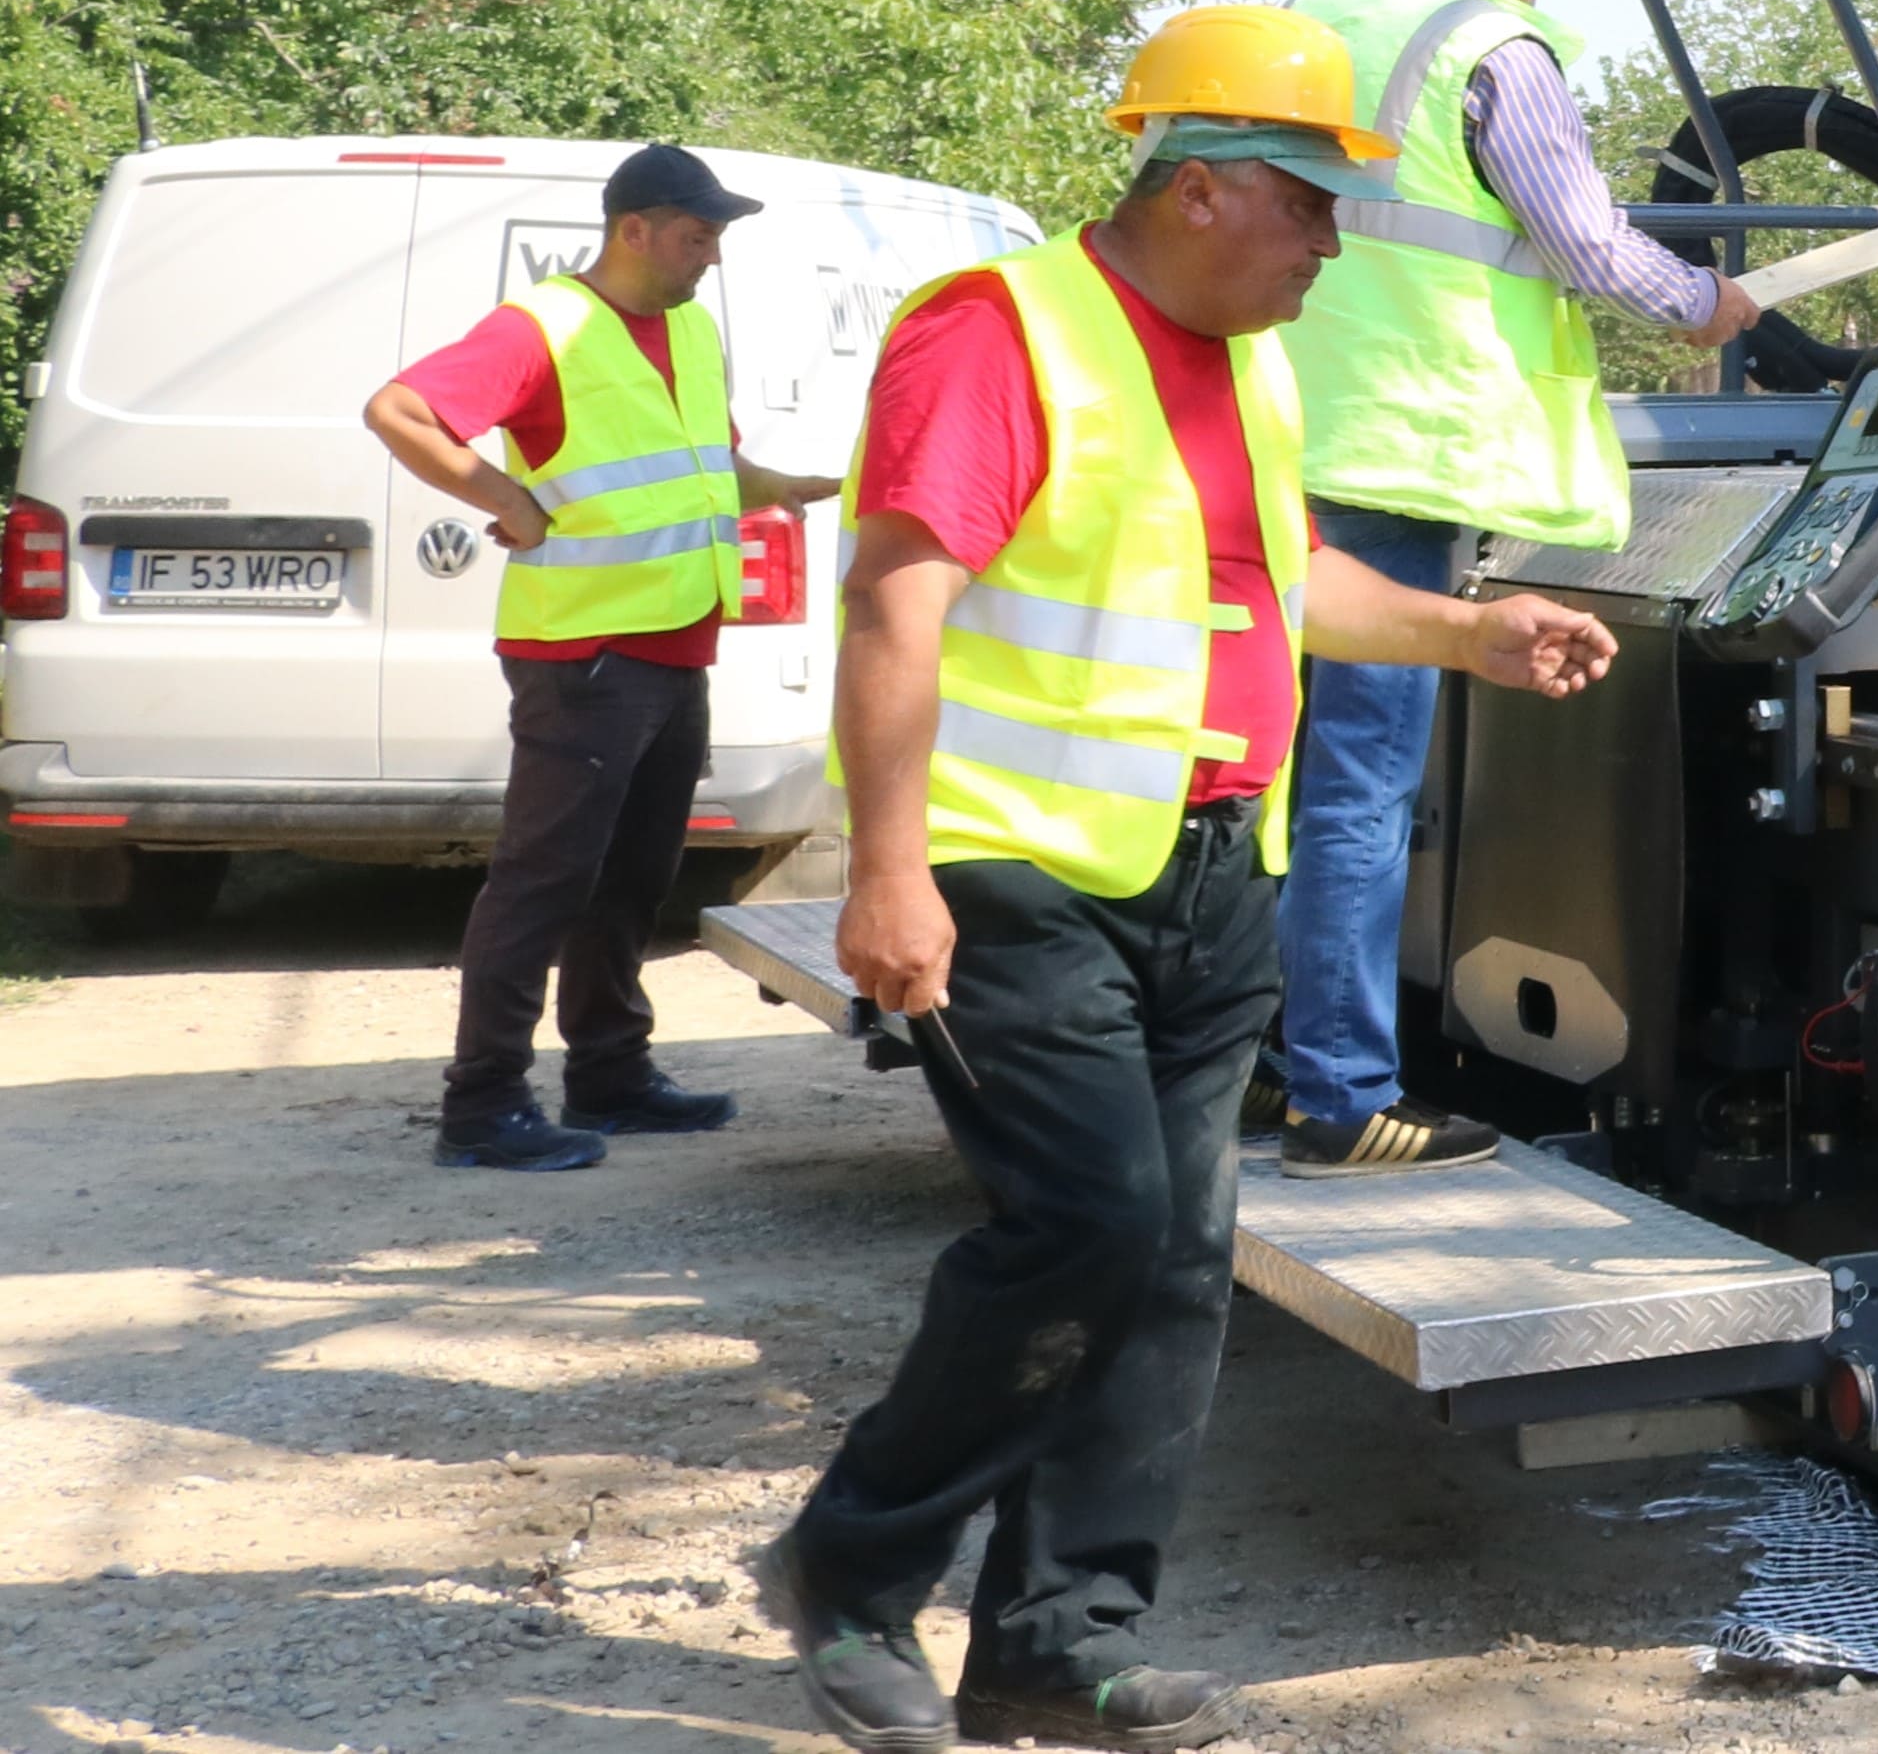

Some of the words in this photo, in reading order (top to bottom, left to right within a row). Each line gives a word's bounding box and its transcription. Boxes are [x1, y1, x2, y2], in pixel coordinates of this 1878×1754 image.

[81, 496, 231, 511] TRANSPORTER
[139, 555, 176, 590] IF
[191, 555, 236, 590] 53
[246, 555, 332, 591] WRO
